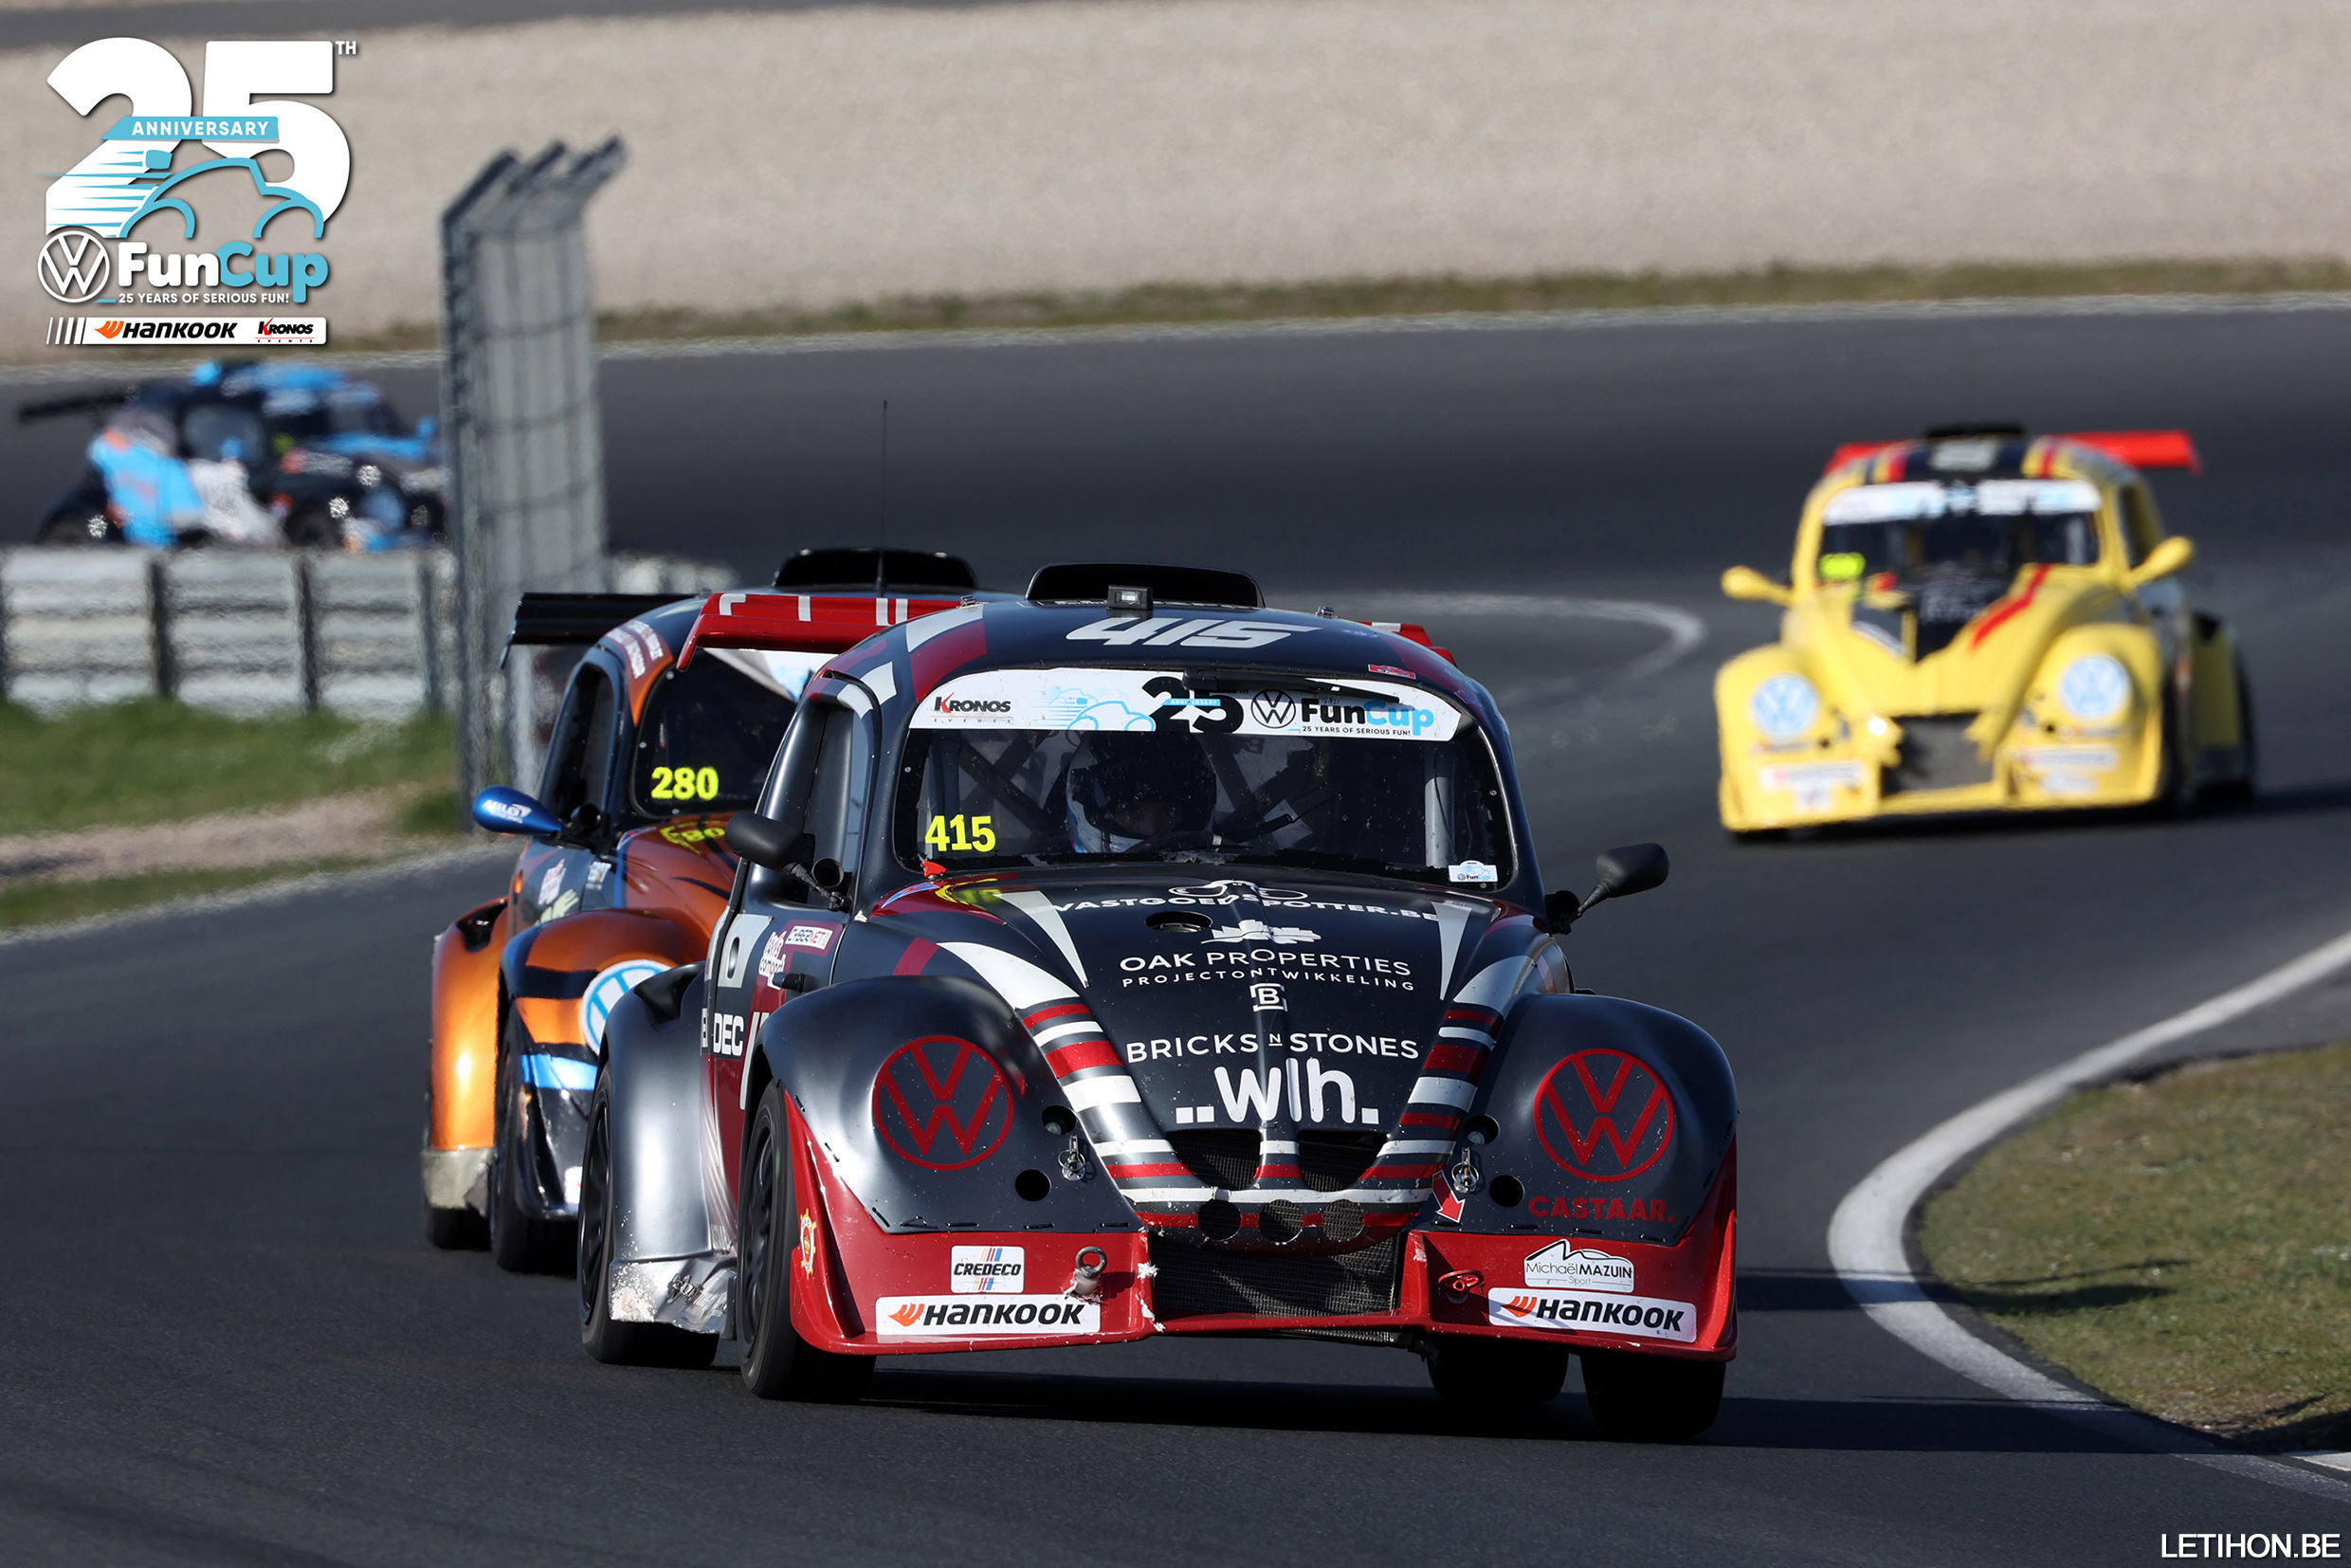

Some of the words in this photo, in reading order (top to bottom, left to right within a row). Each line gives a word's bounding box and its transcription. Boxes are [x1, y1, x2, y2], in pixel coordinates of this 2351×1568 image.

[1066, 617, 1323, 648] 415
[934, 692, 1011, 713] KRONOS
[1302, 698, 1434, 736] FunCup
[651, 766, 719, 800] 280
[925, 814, 996, 852] 415
[1121, 952, 1194, 972] OAK
[1207, 949, 1412, 977] PROPERTIES
[1122, 967, 1414, 991] PROJECTONTWIKKELING
[1126, 1033, 1259, 1064] BRICKS
[1268, 1032, 1283, 1044] N
[1289, 1033, 1419, 1059] STONES
[954, 1263, 1022, 1276] CREDECO
[1568, 1276, 1592, 1285] Sport
